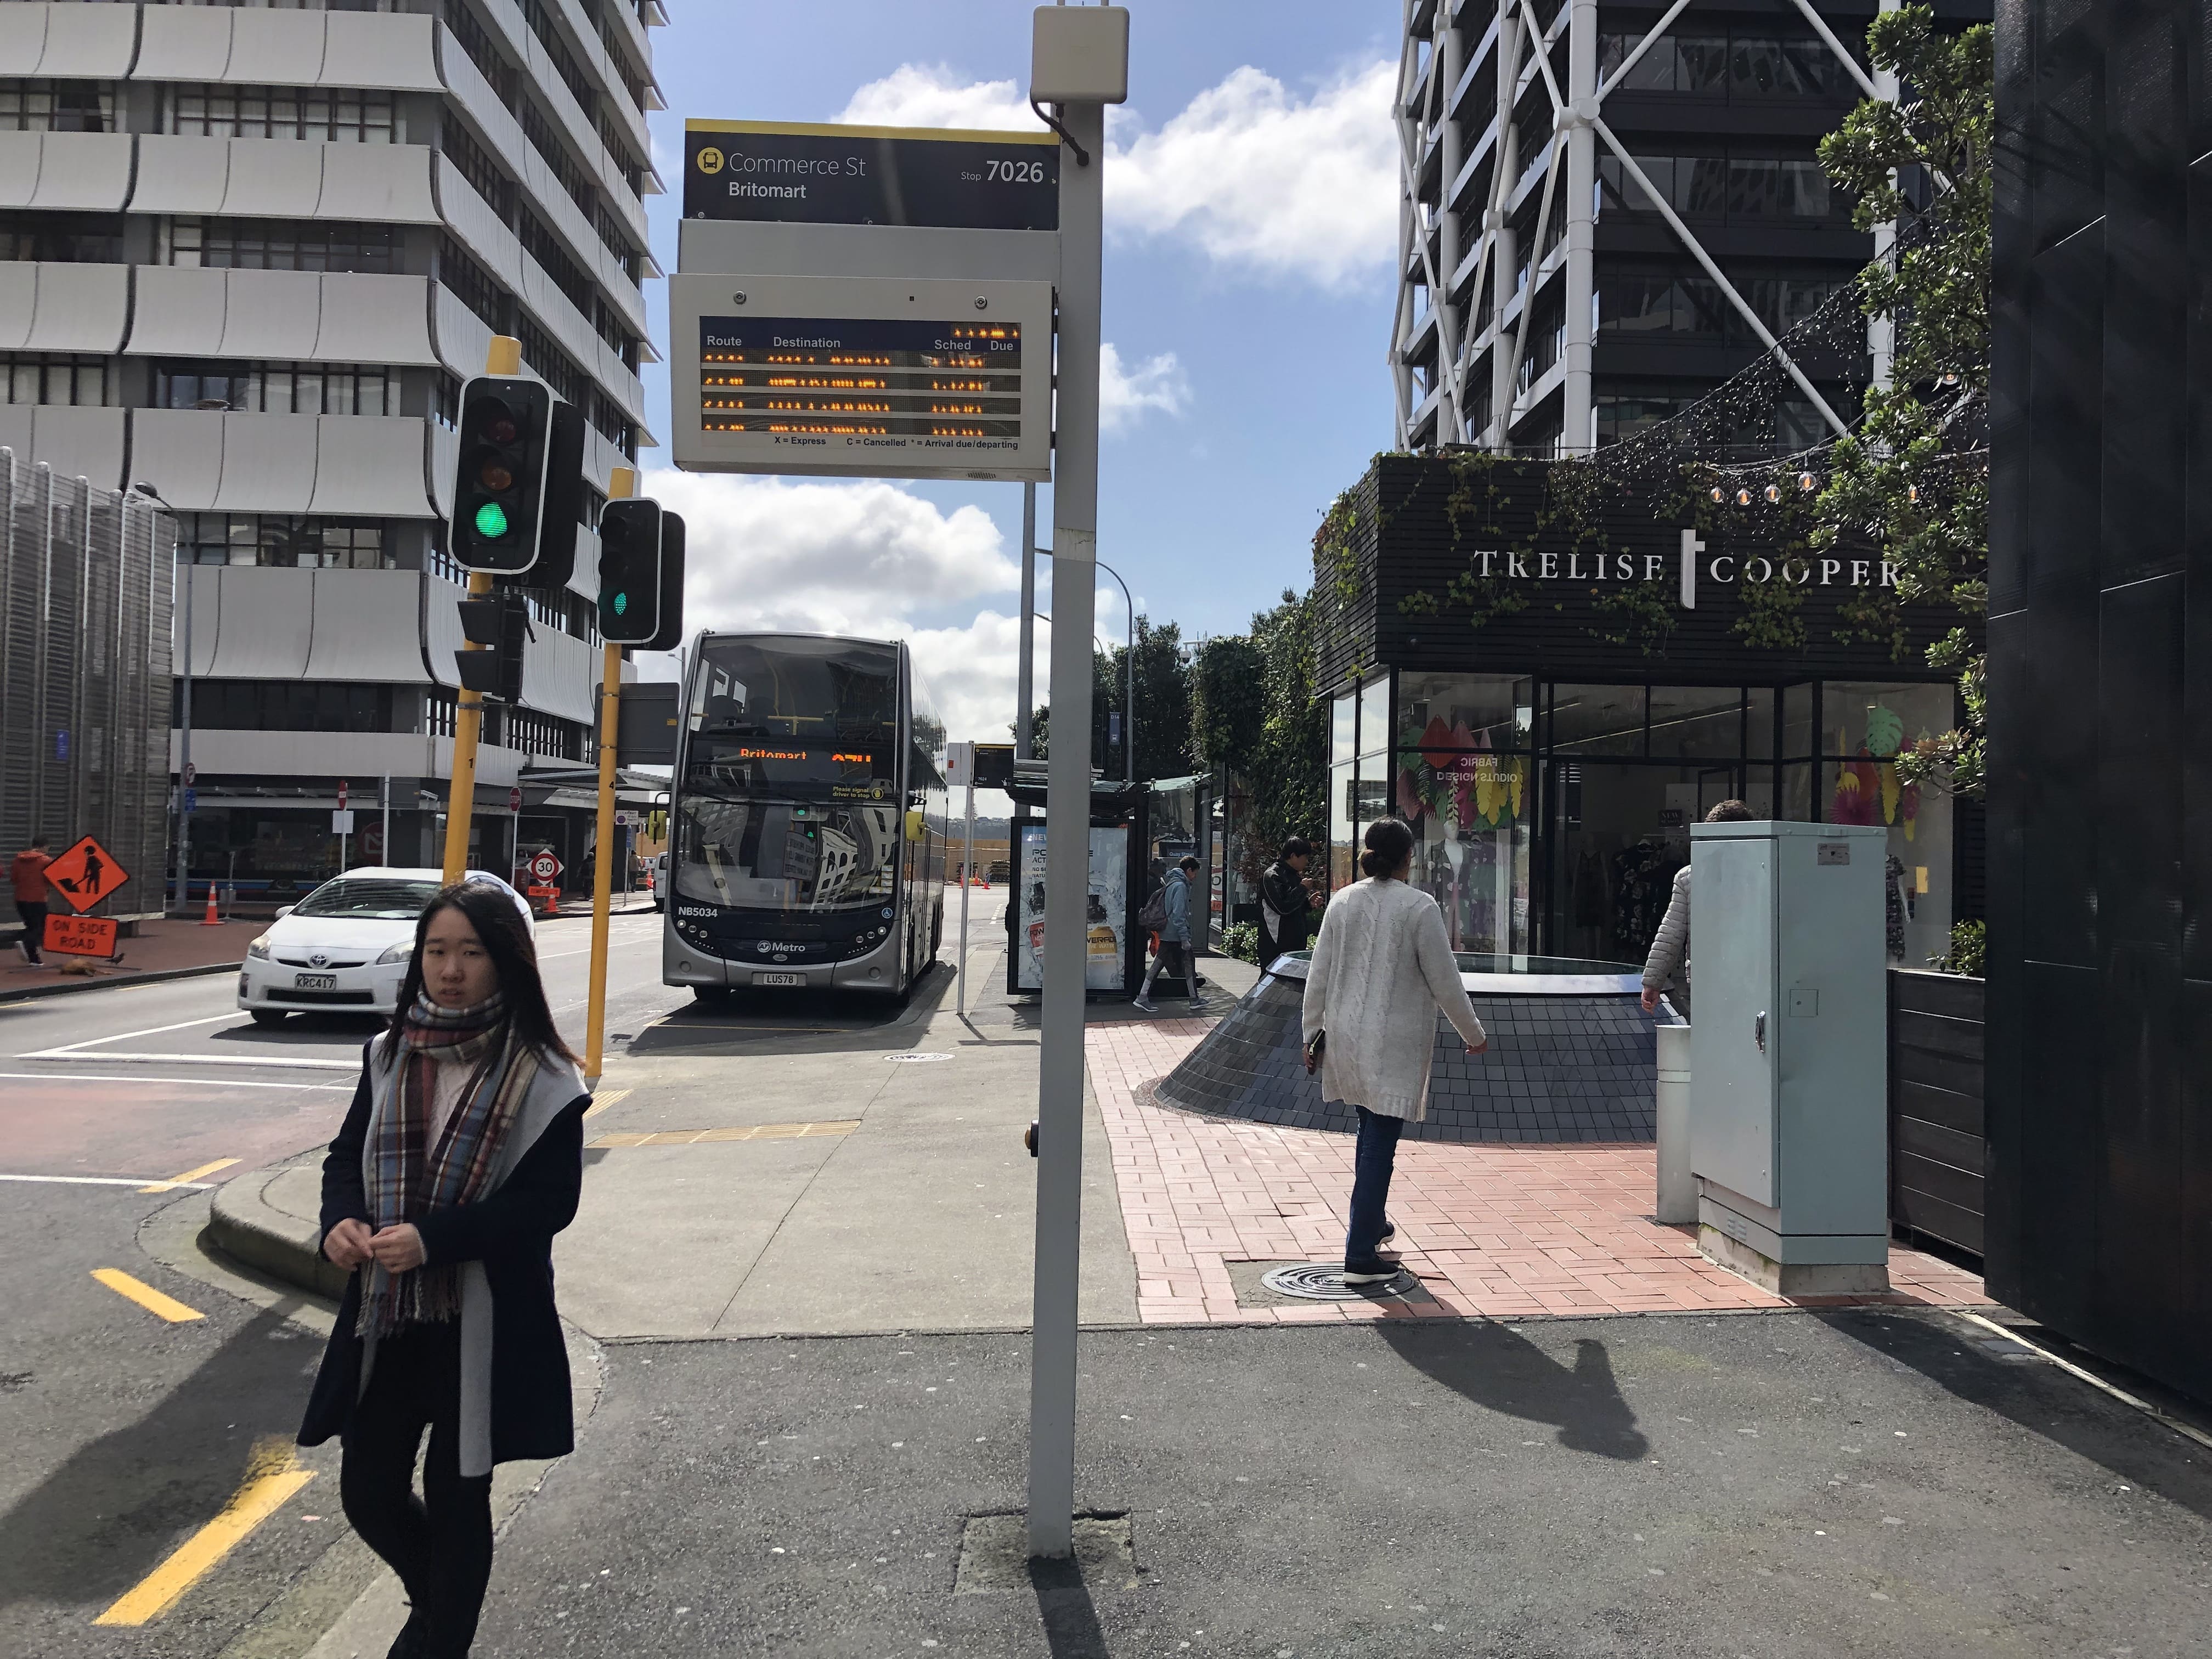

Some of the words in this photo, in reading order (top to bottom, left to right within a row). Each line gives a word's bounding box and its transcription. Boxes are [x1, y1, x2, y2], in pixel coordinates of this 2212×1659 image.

[730, 153, 839, 175] Commerce
[845, 157, 866, 176] St
[961, 171, 981, 182] Stop
[986, 160, 1043, 183] 7026
[729, 182, 806, 199] Britomart
[707, 335, 742, 346] Route
[774, 336, 841, 348] Destination
[934, 339, 972, 350] Sched
[990, 340, 1014, 351] Due
[791, 437, 826, 446] Express
[864, 438, 906, 447] Cancelled
[956, 440, 1018, 450] due/departing
[1474, 549, 1663, 582] TRELISE
[1710, 556, 1900, 587] COOPER
[469, 758, 473, 768] 1
[609, 781, 614, 789] 4
[538, 862, 552, 872] 30
[678, 906, 718, 918] NB5034
[53, 920, 70, 932] ON
[78, 923, 108, 935] SIDE
[60, 936, 96, 950] ROAD
[772, 942, 806, 952] Metro
[297, 977, 334, 989] KRC417
[766, 975, 793, 984] LUS78
